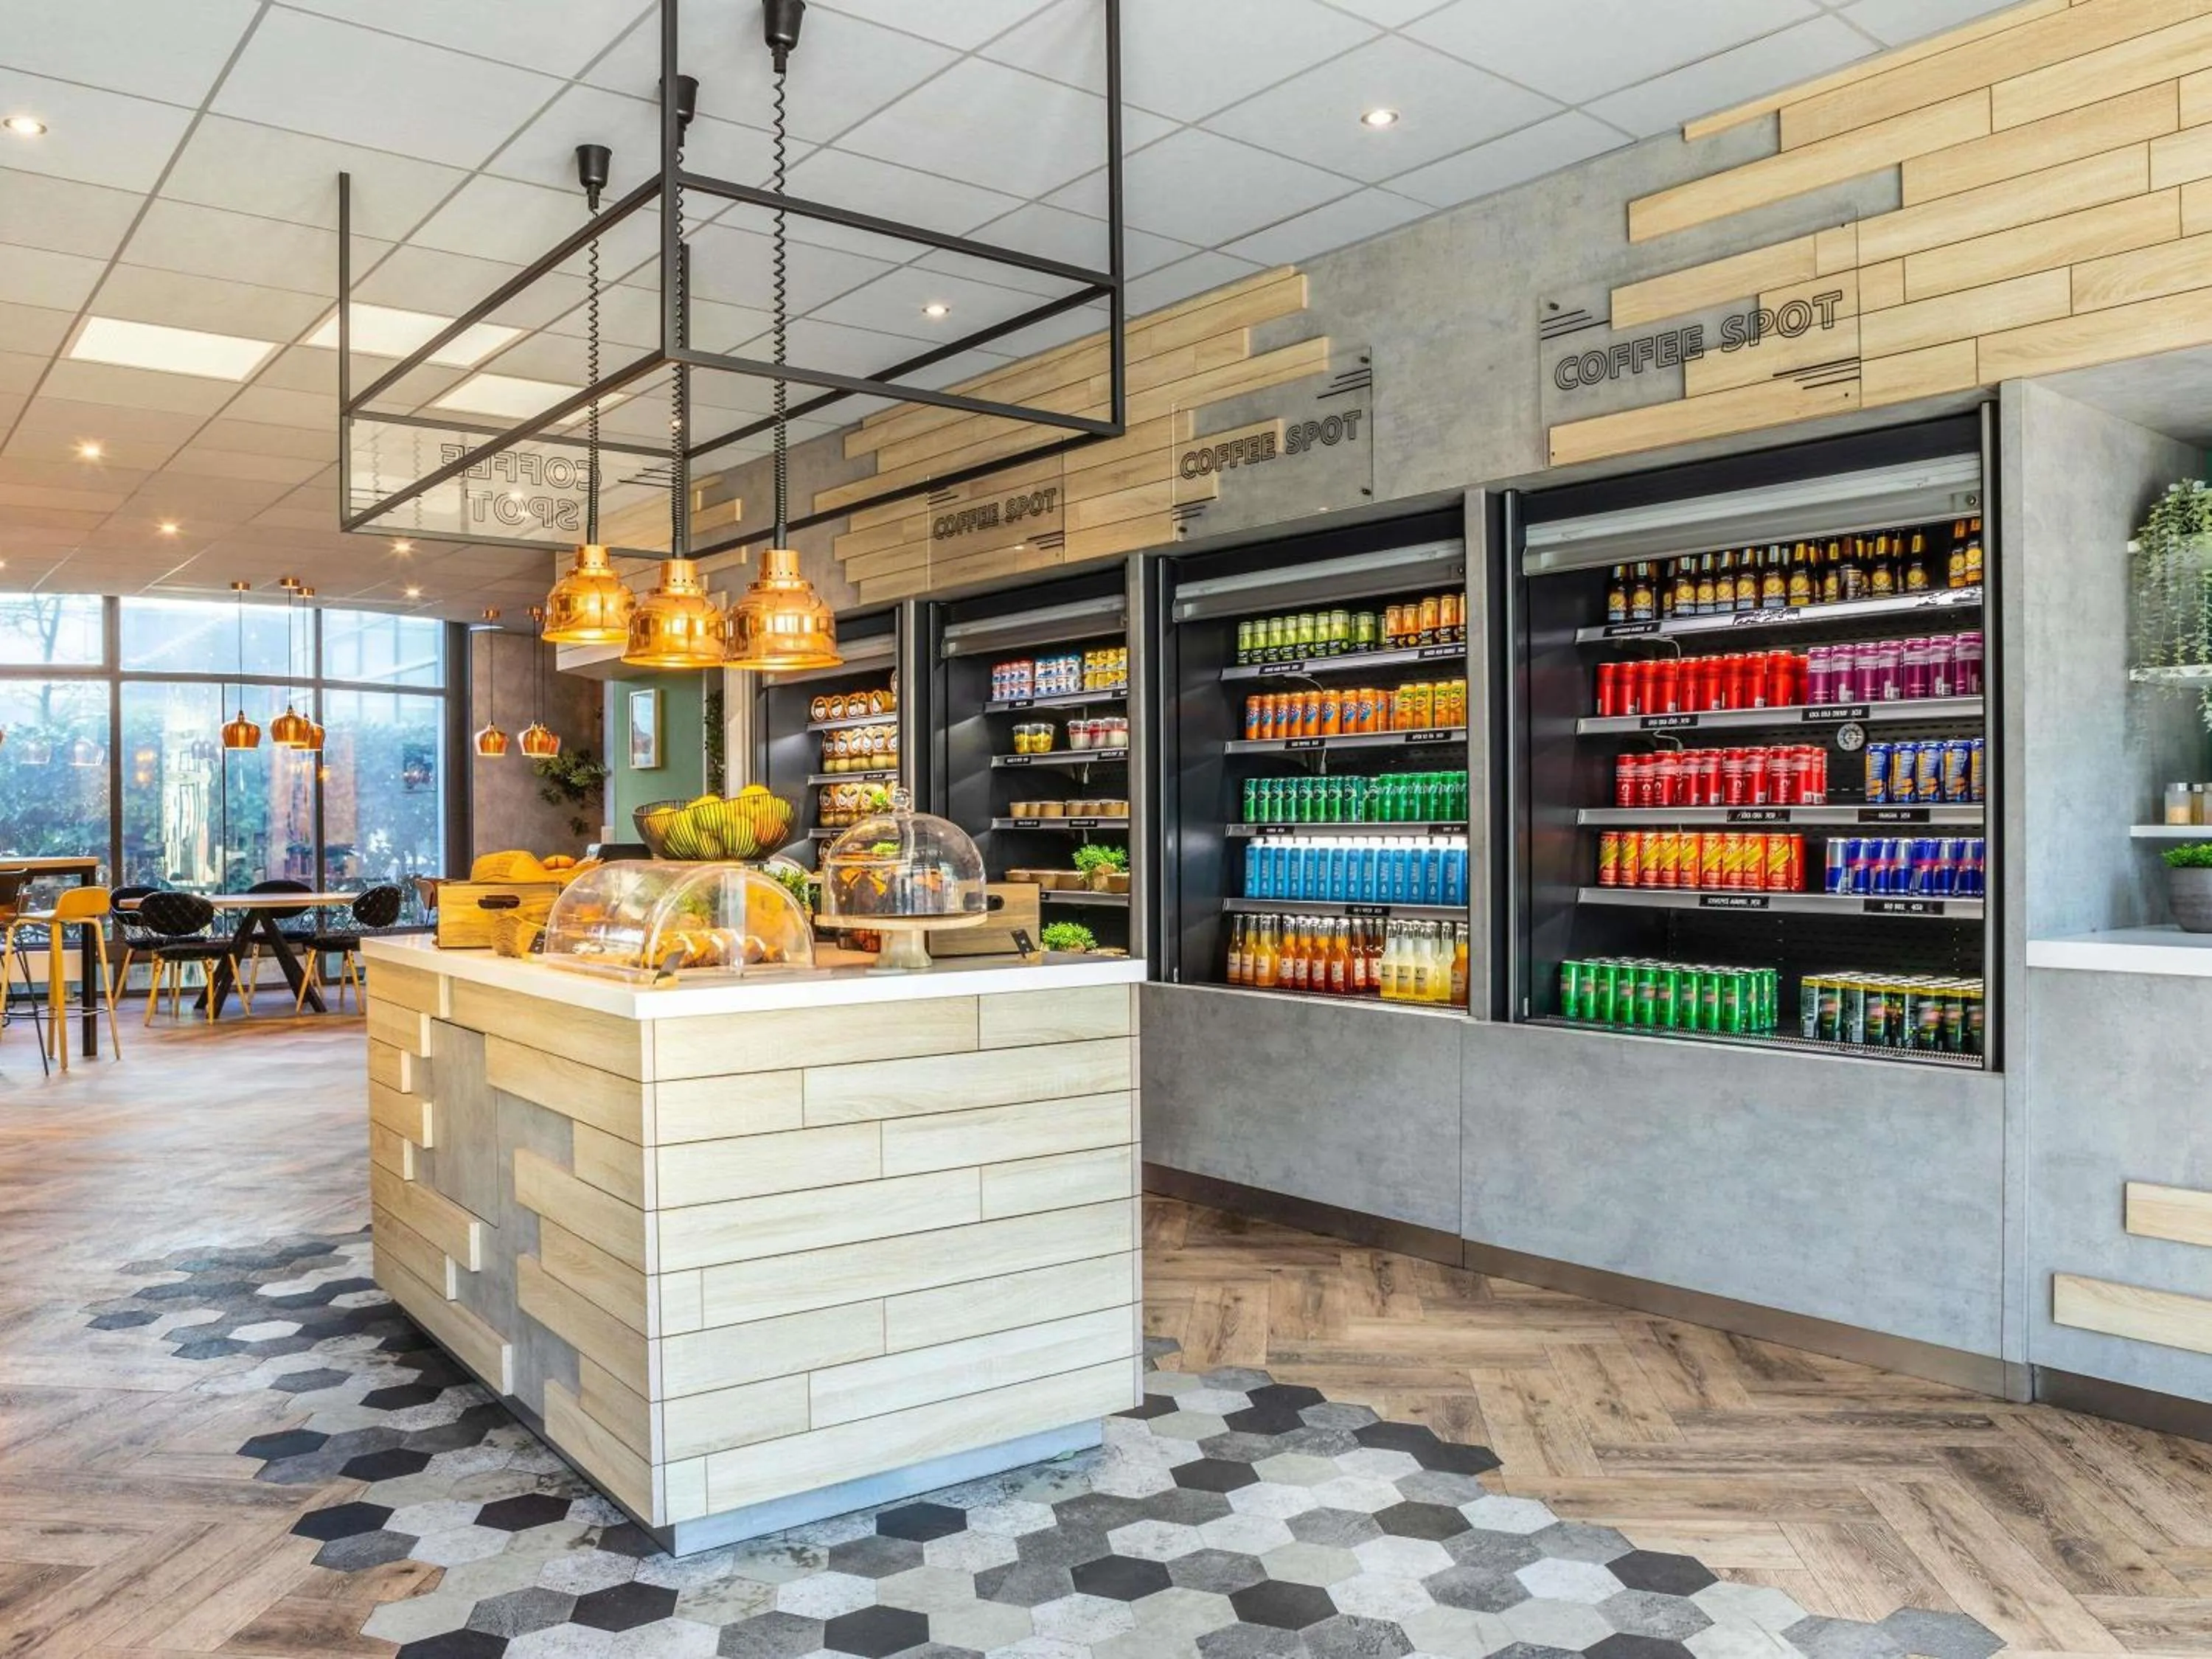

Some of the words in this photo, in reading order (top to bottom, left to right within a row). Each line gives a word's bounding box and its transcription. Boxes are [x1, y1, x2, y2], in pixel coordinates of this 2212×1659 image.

[1554, 324, 1705, 391] COFFEE
[1720, 289, 1843, 353] SPOT
[1180, 431, 1276, 479] COFFEE
[1285, 409, 1362, 455] SPOT
[933, 502, 999, 540] COFFEE
[1005, 488, 1057, 522] SPOT
